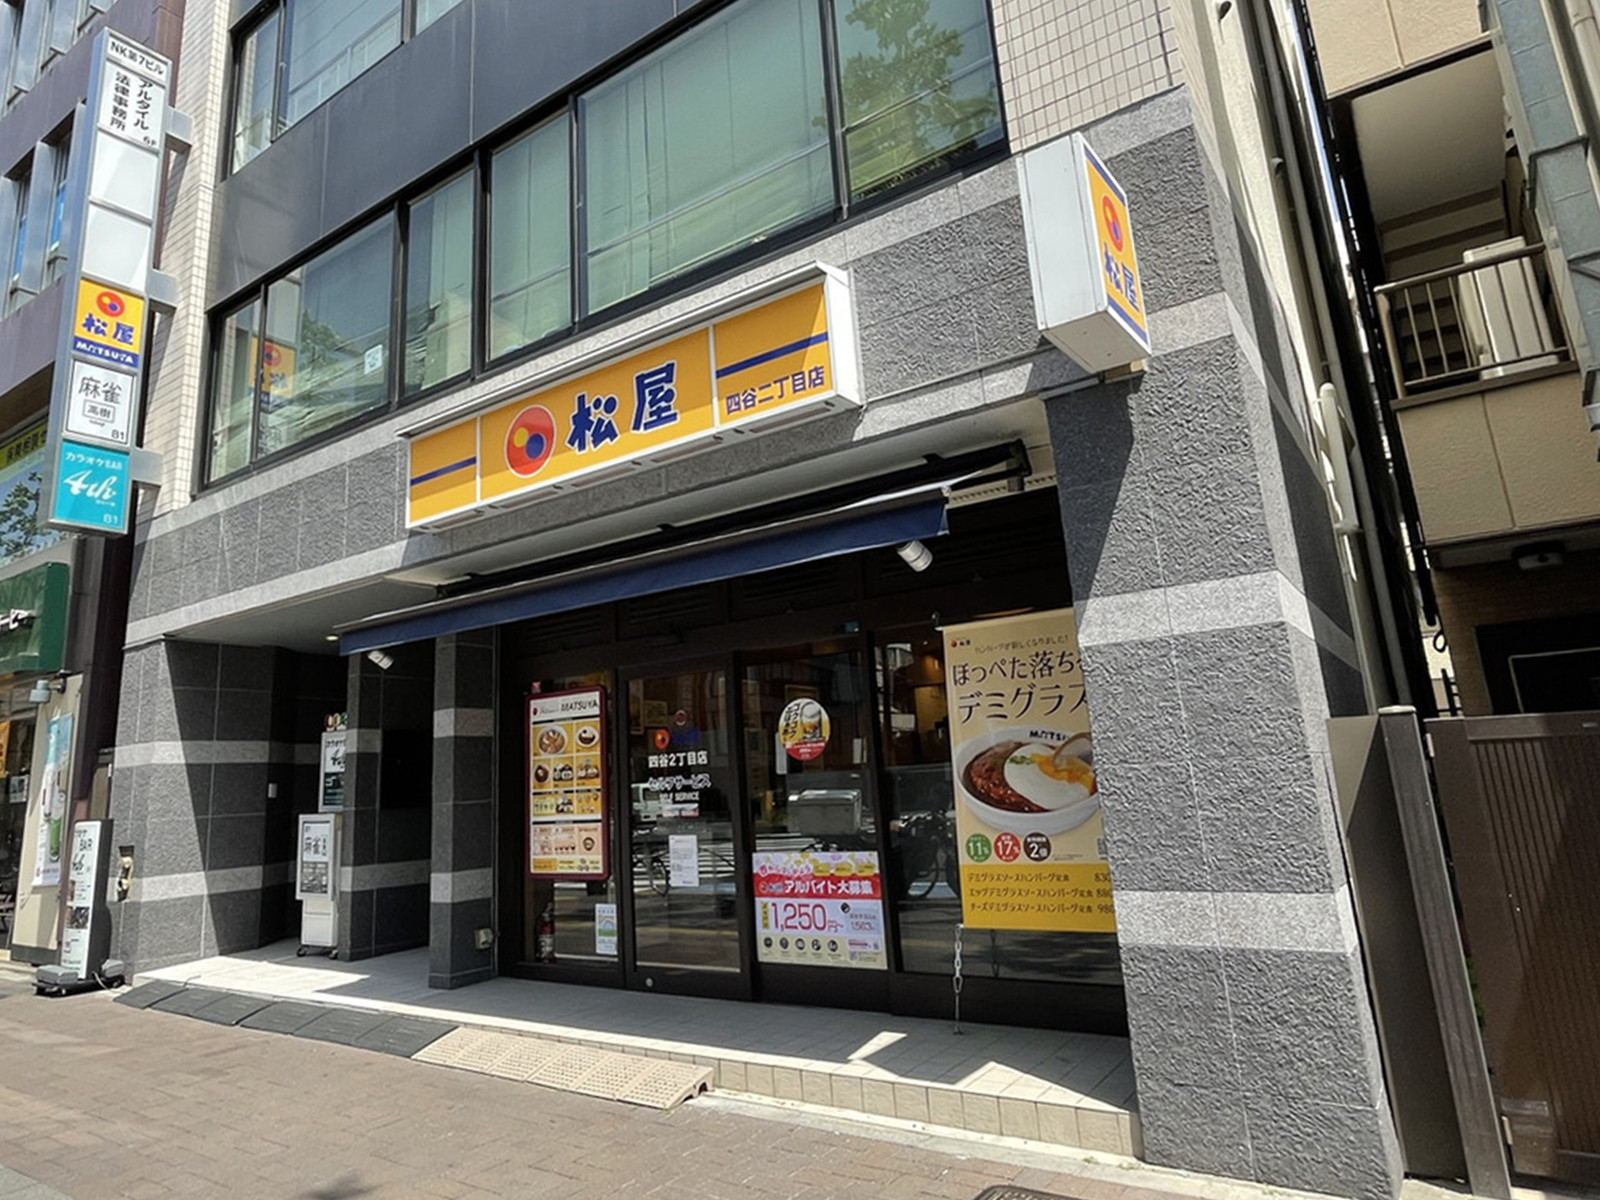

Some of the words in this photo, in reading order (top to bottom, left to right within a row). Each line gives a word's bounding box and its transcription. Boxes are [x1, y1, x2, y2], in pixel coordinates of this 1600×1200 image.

[109, 71, 130, 131] 法律事務所
[133, 77, 153, 131] アルタイル
[1102, 241, 1140, 314] 松屋
[82, 313, 135, 346] 松屋
[79, 376, 122, 405] 麻雀
[566, 360, 678, 453] 松屋
[725, 365, 825, 415] 四谷二丁目店
[953, 650, 1083, 686] ほっぺた落ち
[648, 751, 708, 768] 四谷2丁目店
[784, 880, 873, 895] アルバイト大募集
